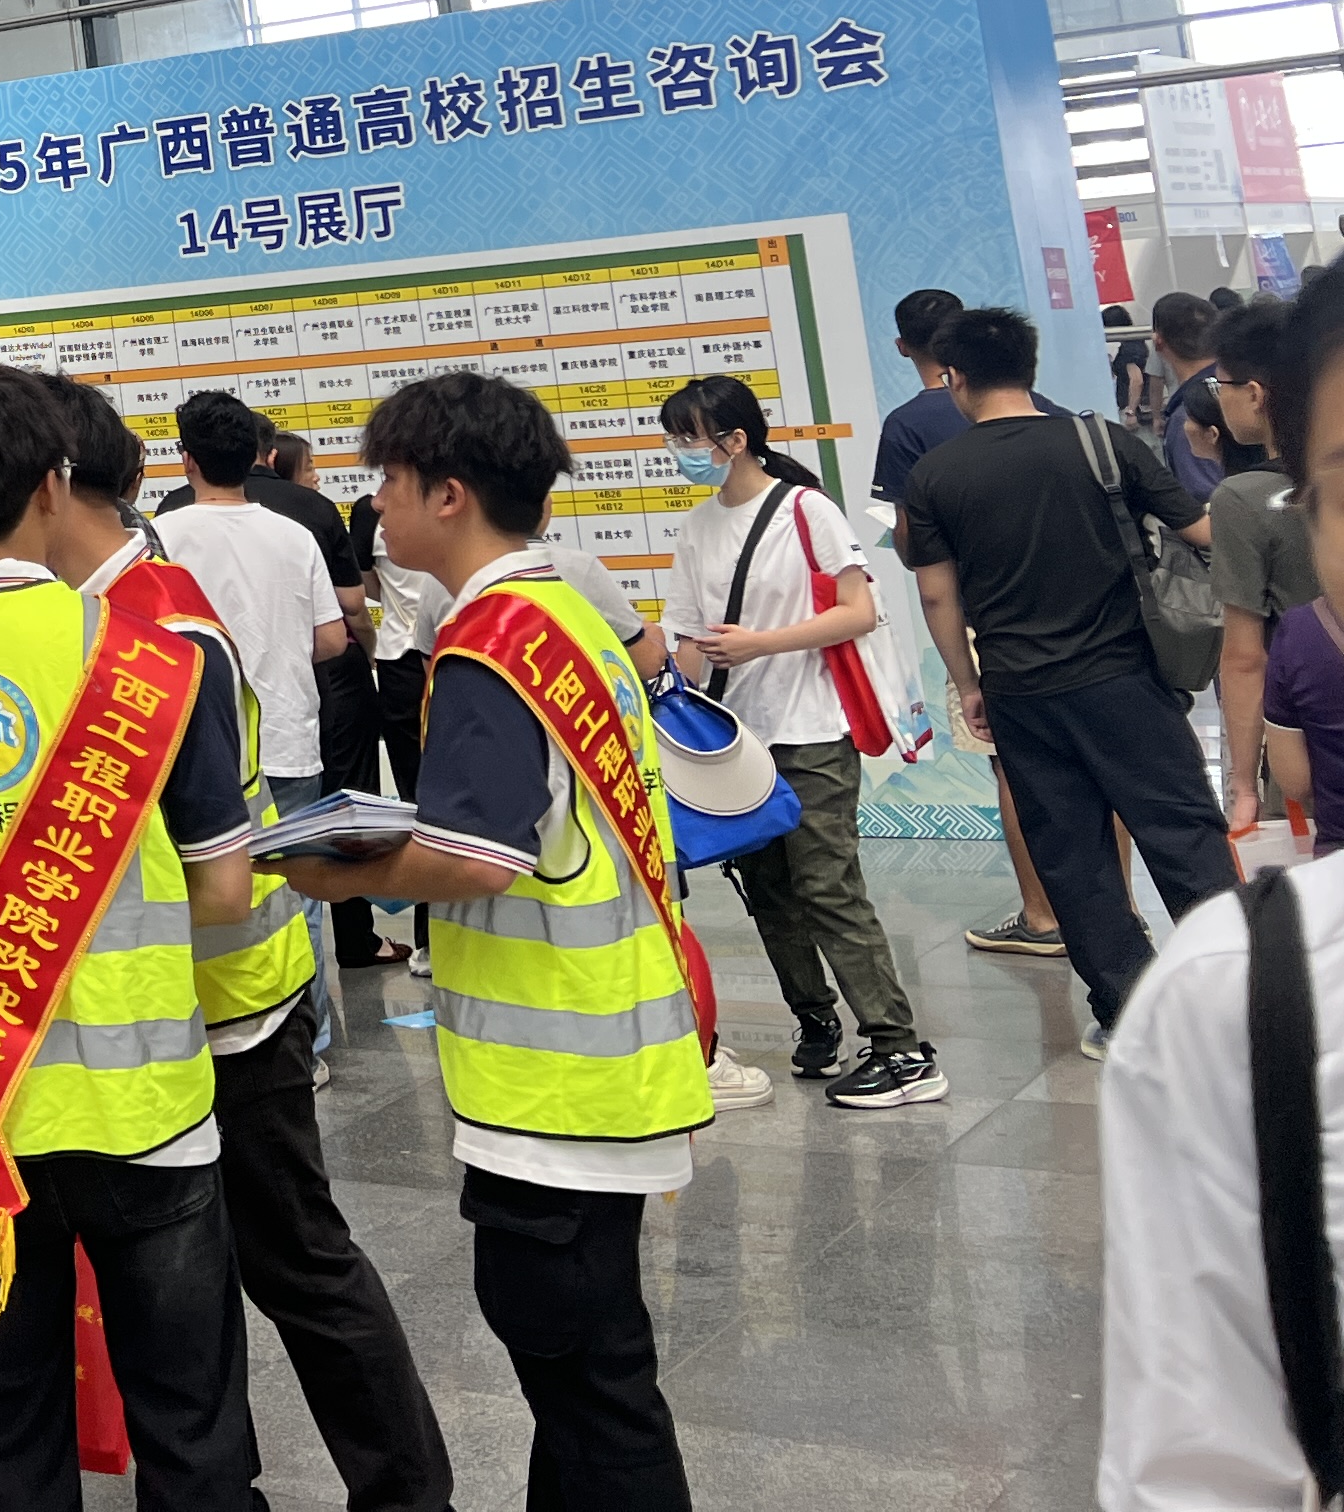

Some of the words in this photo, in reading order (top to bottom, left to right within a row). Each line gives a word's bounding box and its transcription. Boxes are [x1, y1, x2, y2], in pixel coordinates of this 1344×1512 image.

[178, 184, 404, 257] 14号展厅
[705, 258, 734, 269] 14D14
[630, 266, 659, 276] 14D13
[562, 272, 591, 283] 14D12
[495, 279, 521, 289] 14D11
[432, 286, 459, 295] 14D10
[695, 289, 755, 303] 南昌理工学院
[619, 290, 678, 304] 广东科学技术
[484, 303, 539, 316] 广东工商职业
[631, 302, 670, 314] 职业学院
[365, 313, 417, 326] 广东艺术职业
[495, 315, 531, 326] 技术大学
[322, 331, 338, 340] 学院
[384, 326, 401, 335] 学院
[702, 340, 762, 354] 重庆外语外事
[627, 346, 686, 360] 重庆轻工职业
[560, 357, 618, 371] 重庆移通学院
[648, 359, 668, 369] 学院
[723, 354, 744, 364] 学院
[647, 380, 675, 389] 14C27
[264, 389, 281, 398] 大学
[327, 403, 352, 412] 14C22
[581, 398, 608, 408] 14C12
[263, 407, 287, 416] 14C21
[318, 435, 363, 447] 重庆理工大
[341, 484, 359, 495] 大学
[594, 530, 633, 540] 南昌大学
